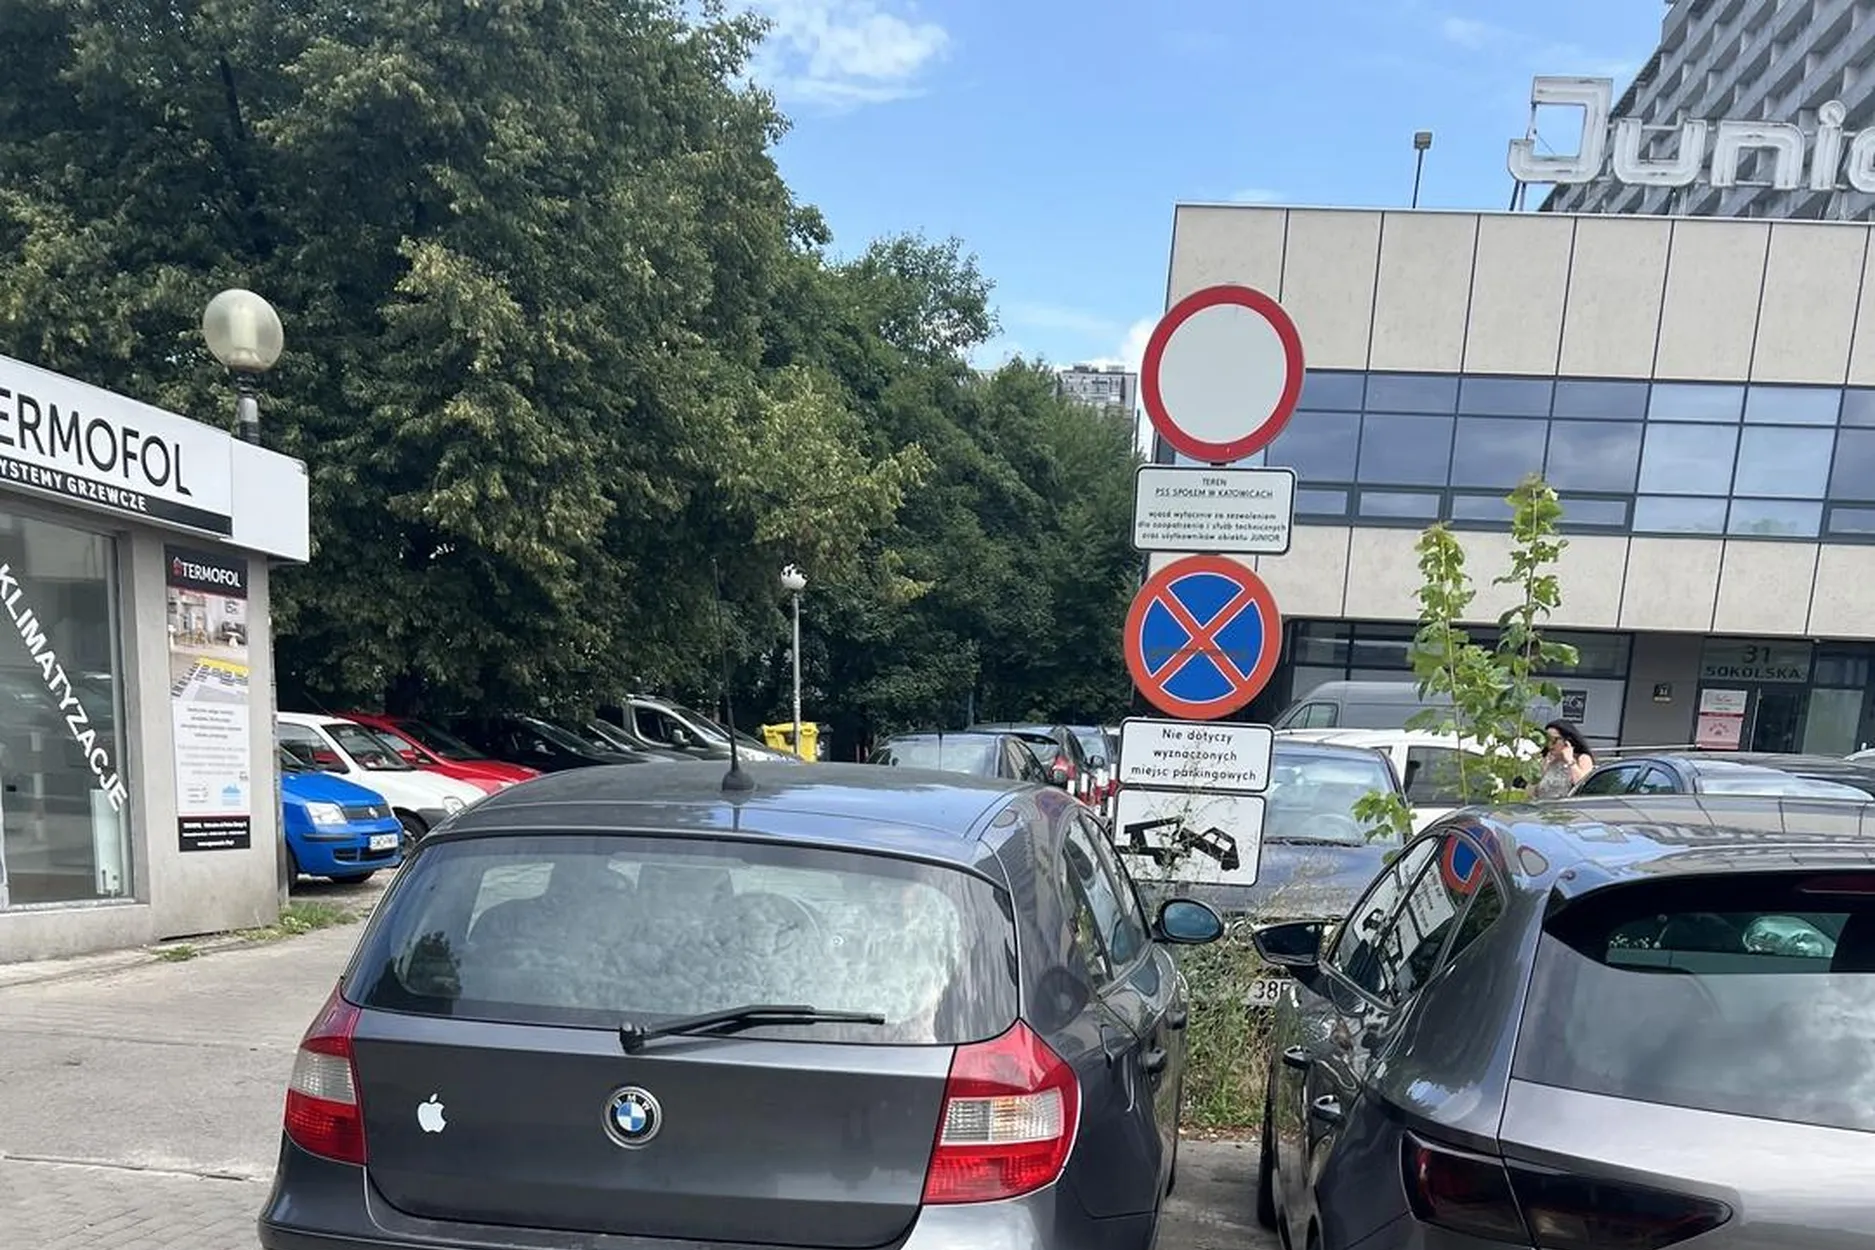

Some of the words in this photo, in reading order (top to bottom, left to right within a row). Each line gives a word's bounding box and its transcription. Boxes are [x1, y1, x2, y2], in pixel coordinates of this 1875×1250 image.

[1508, 76, 1875, 193] Juni
[1202, 478, 1227, 486] TEREN
[67, 479, 147, 511] GRZEWCZE
[1218, 489, 1273, 498] KATOWICACH
[1250, 534, 1280, 542] JUNIOR
[181, 561, 242, 588] TERMOFOL
[1743, 644, 1772, 664] 31
[1706, 665, 1801, 679] SOKOLSKA
[0, 563, 128, 812] KLIMATYZACJE
[1162, 729, 1183, 740] Nie
[1187, 730, 1234, 745] dotyczy
[1153, 749, 1237, 764] wyznaczonych
[1131, 766, 1168, 778] miejsc
[1172, 768, 1257, 782] parkingowych
